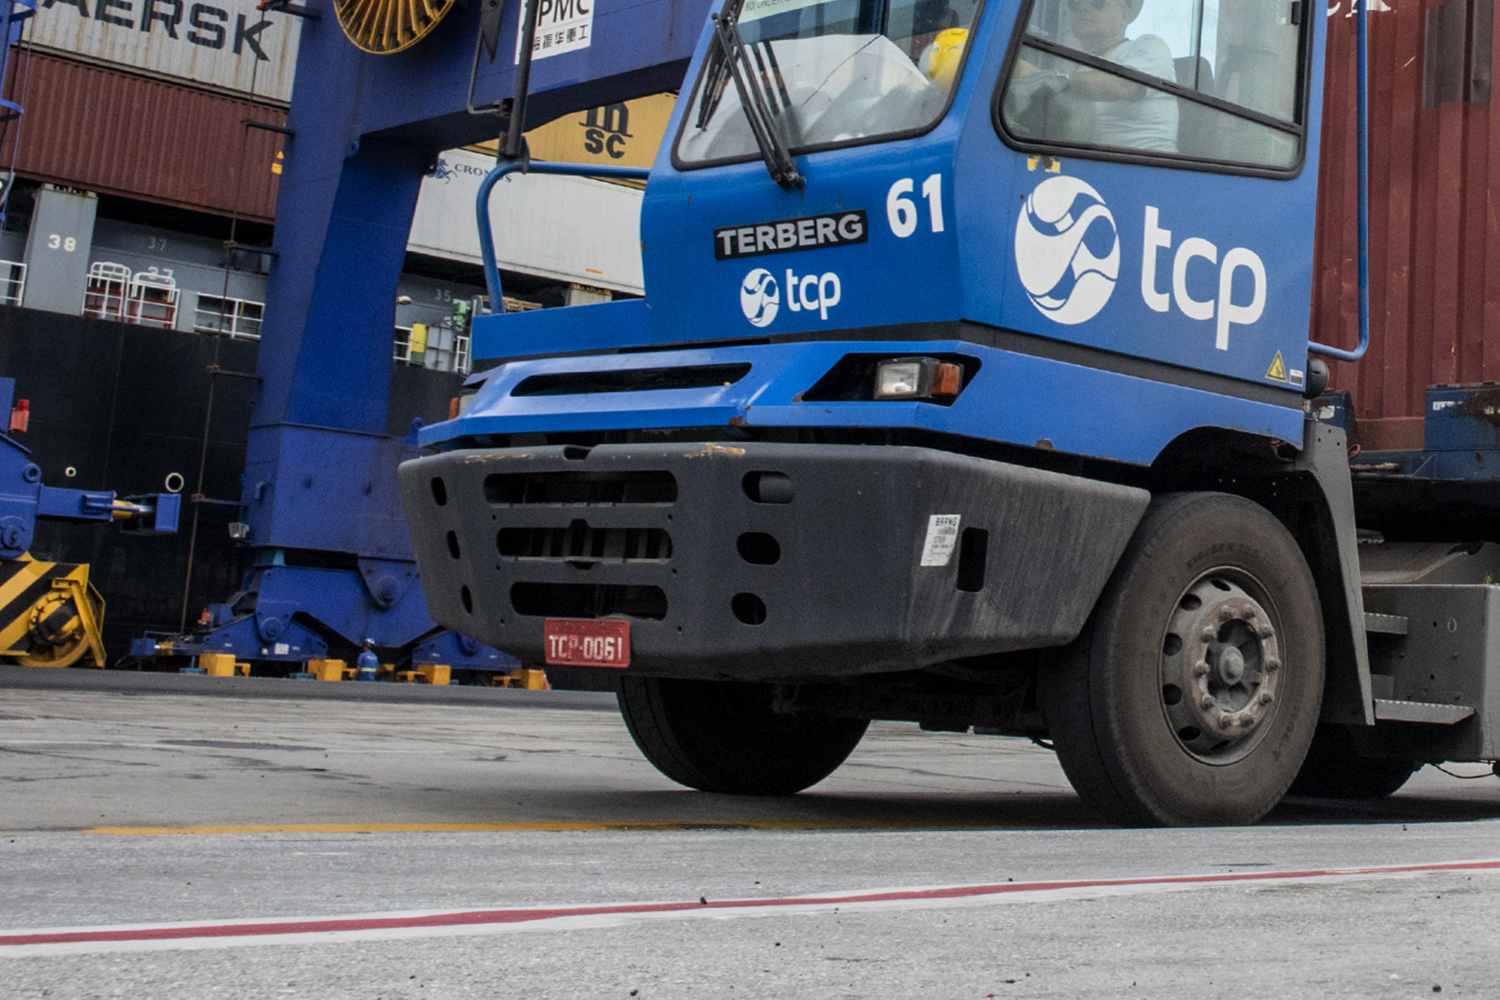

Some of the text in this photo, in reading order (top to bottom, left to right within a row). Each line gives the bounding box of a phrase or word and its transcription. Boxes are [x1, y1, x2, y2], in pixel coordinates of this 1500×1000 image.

[886, 172, 945, 238] 61
[47, 234, 77, 252] 38
[716, 214, 864, 256] TERBERG
[433, 289, 451, 302] 35
[786, 268, 842, 320] tcp
[1141, 204, 1268, 352] tcp
